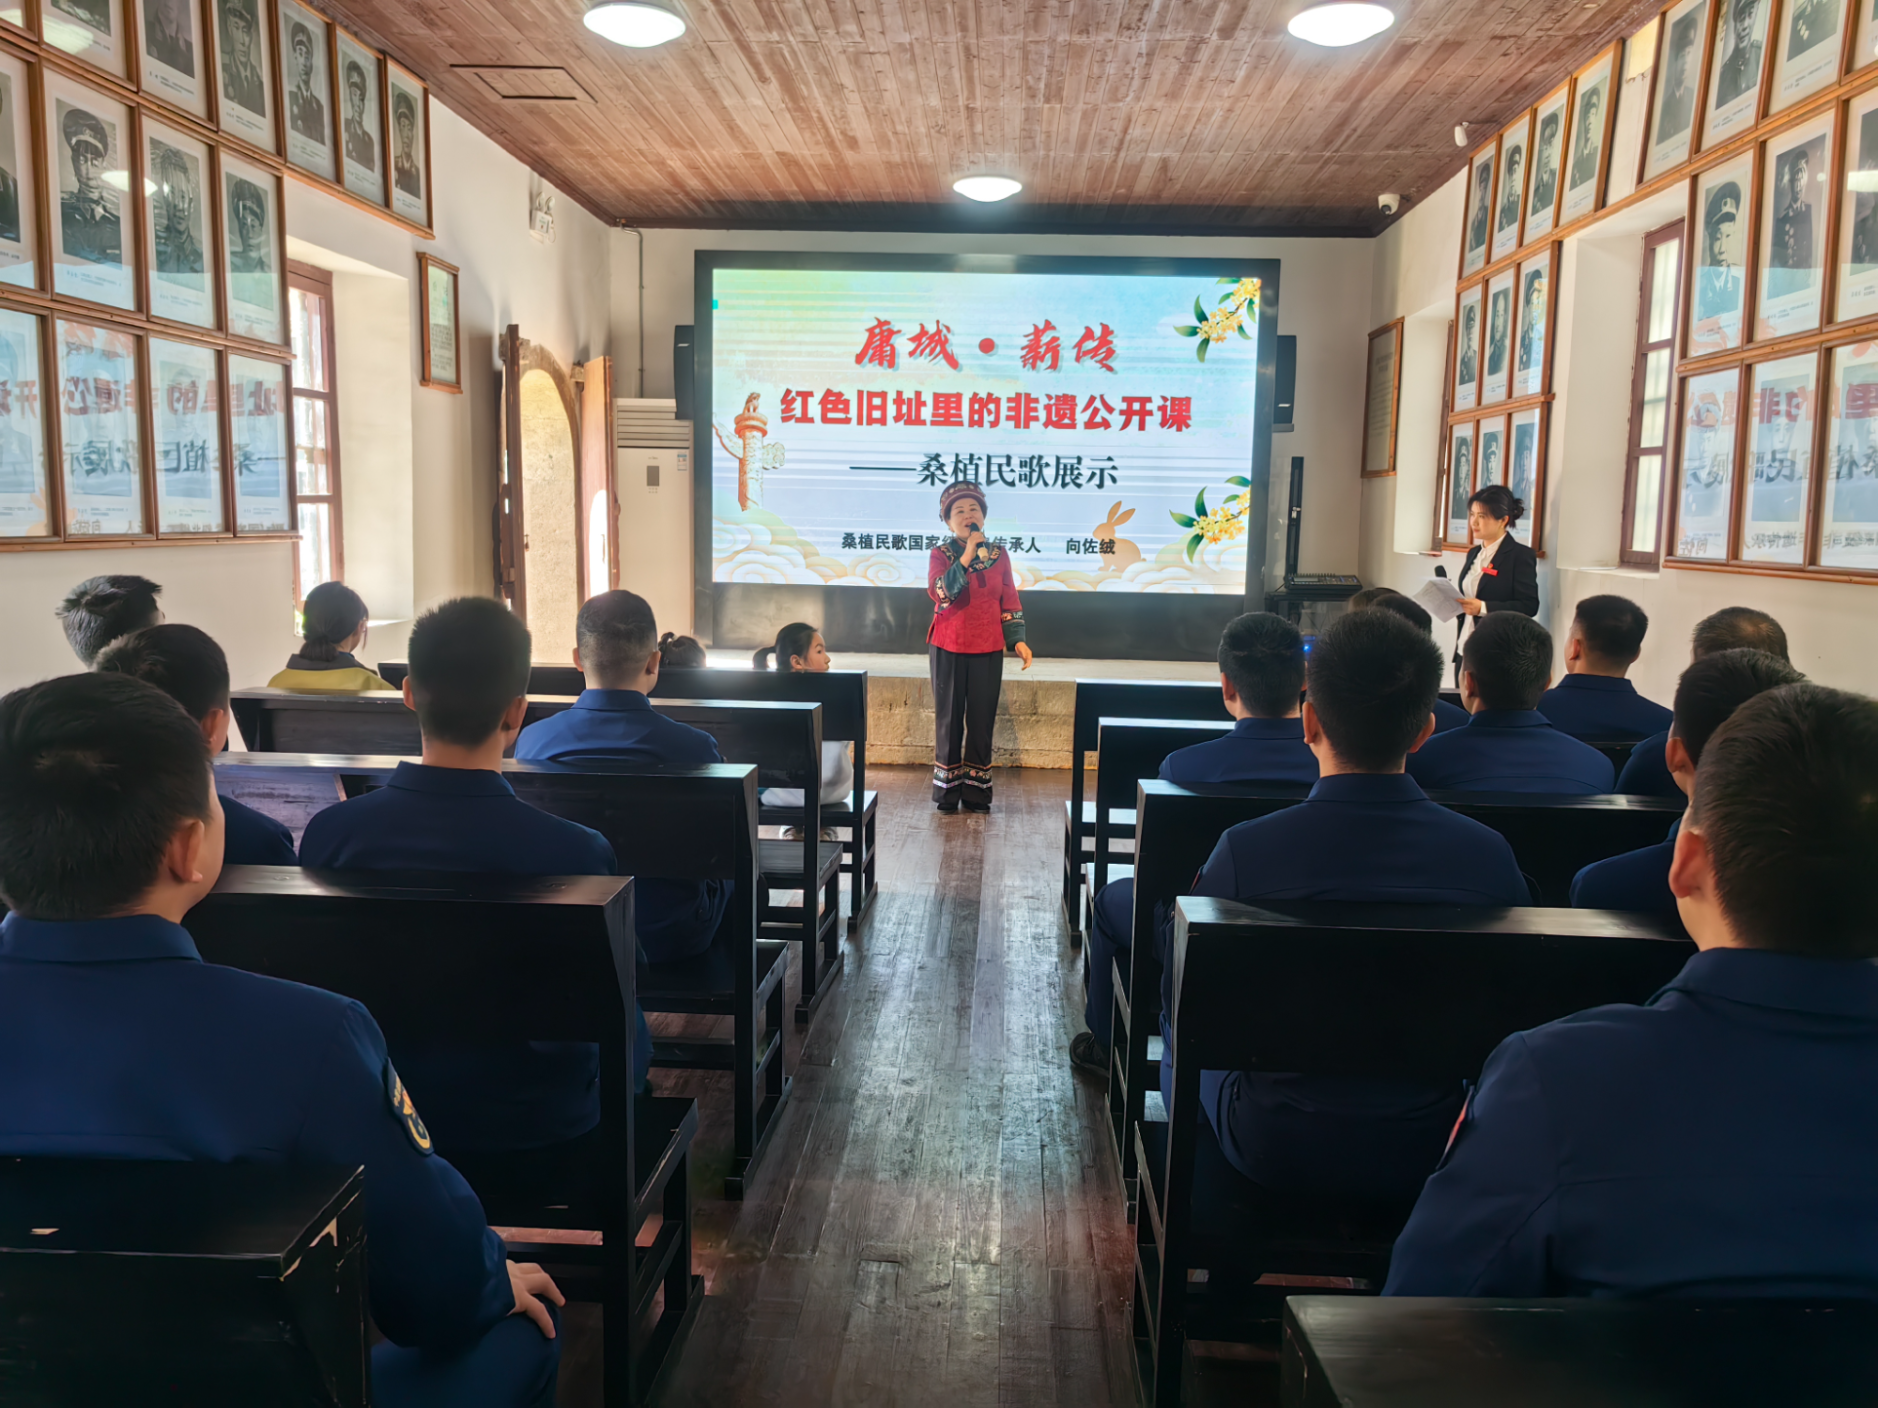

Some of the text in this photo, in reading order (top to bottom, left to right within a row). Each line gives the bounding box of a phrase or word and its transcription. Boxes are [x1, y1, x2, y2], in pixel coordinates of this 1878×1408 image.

[780, 387, 1192, 432] 红色旧址里的非遗公开课
[841, 532, 1116, 555] 桑植民歌国家传承人 向佐绒
